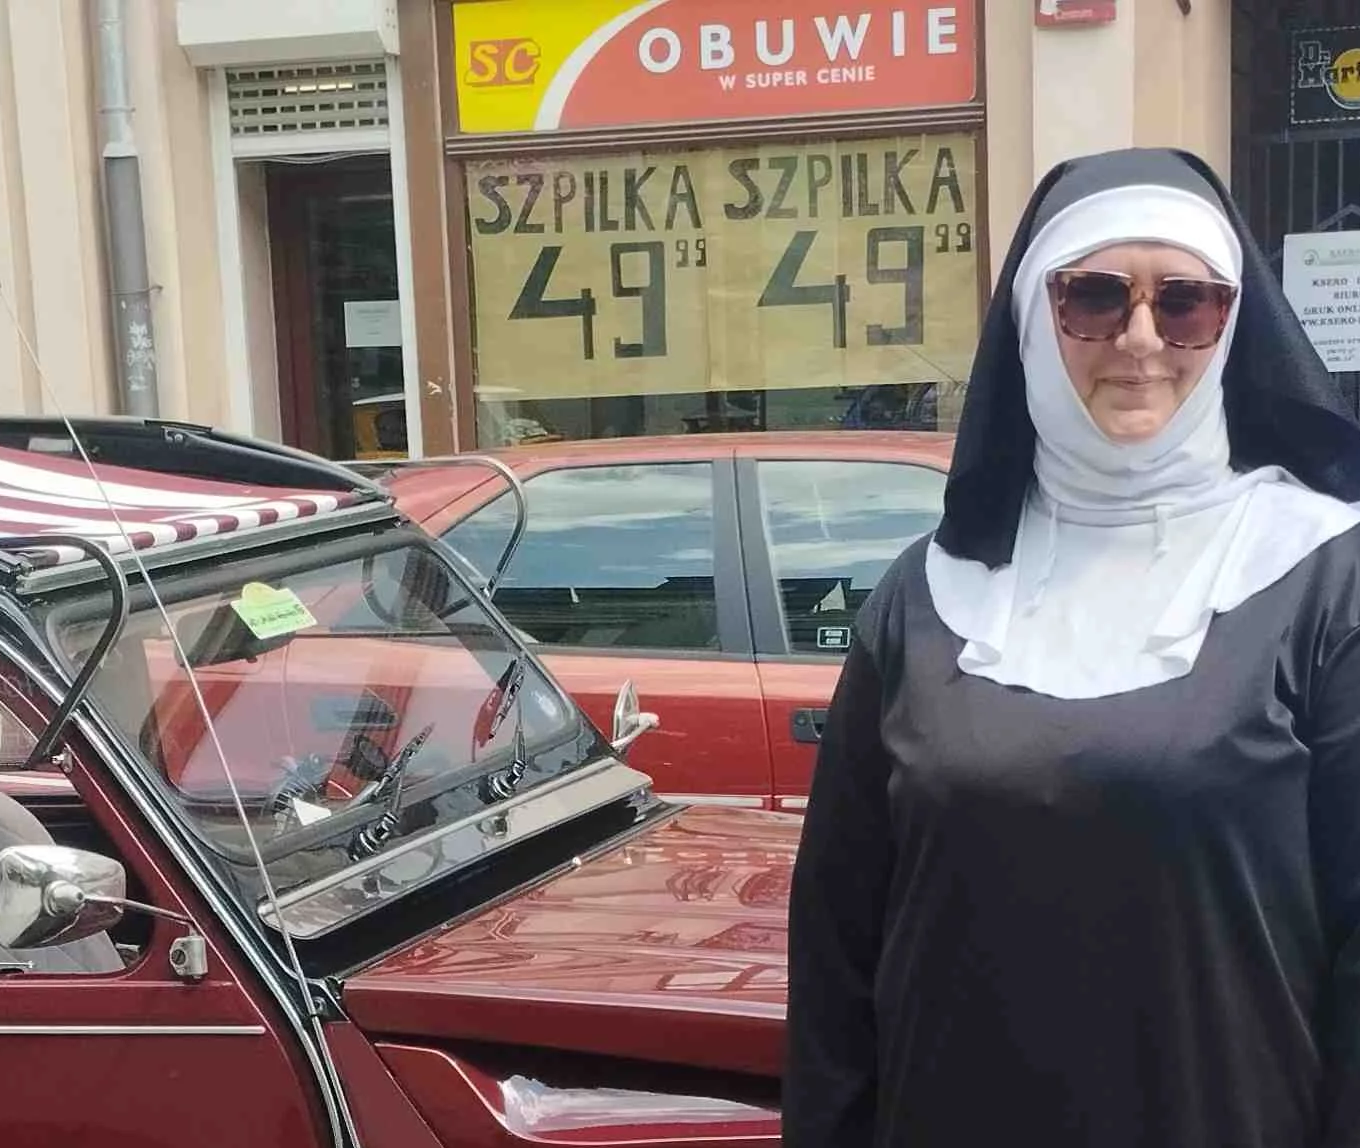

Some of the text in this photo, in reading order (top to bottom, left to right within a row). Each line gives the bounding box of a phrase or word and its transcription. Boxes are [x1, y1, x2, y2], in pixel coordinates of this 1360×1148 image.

[468, 39, 541, 86] SC
[639, 7, 957, 73] OBUWIE
[719, 65, 876, 91] W SUPER CENIE
[475, 147, 966, 235] SZPILKA SZPILKA
[508, 238, 707, 360] 49 99
[756, 222, 971, 350] 49 99
